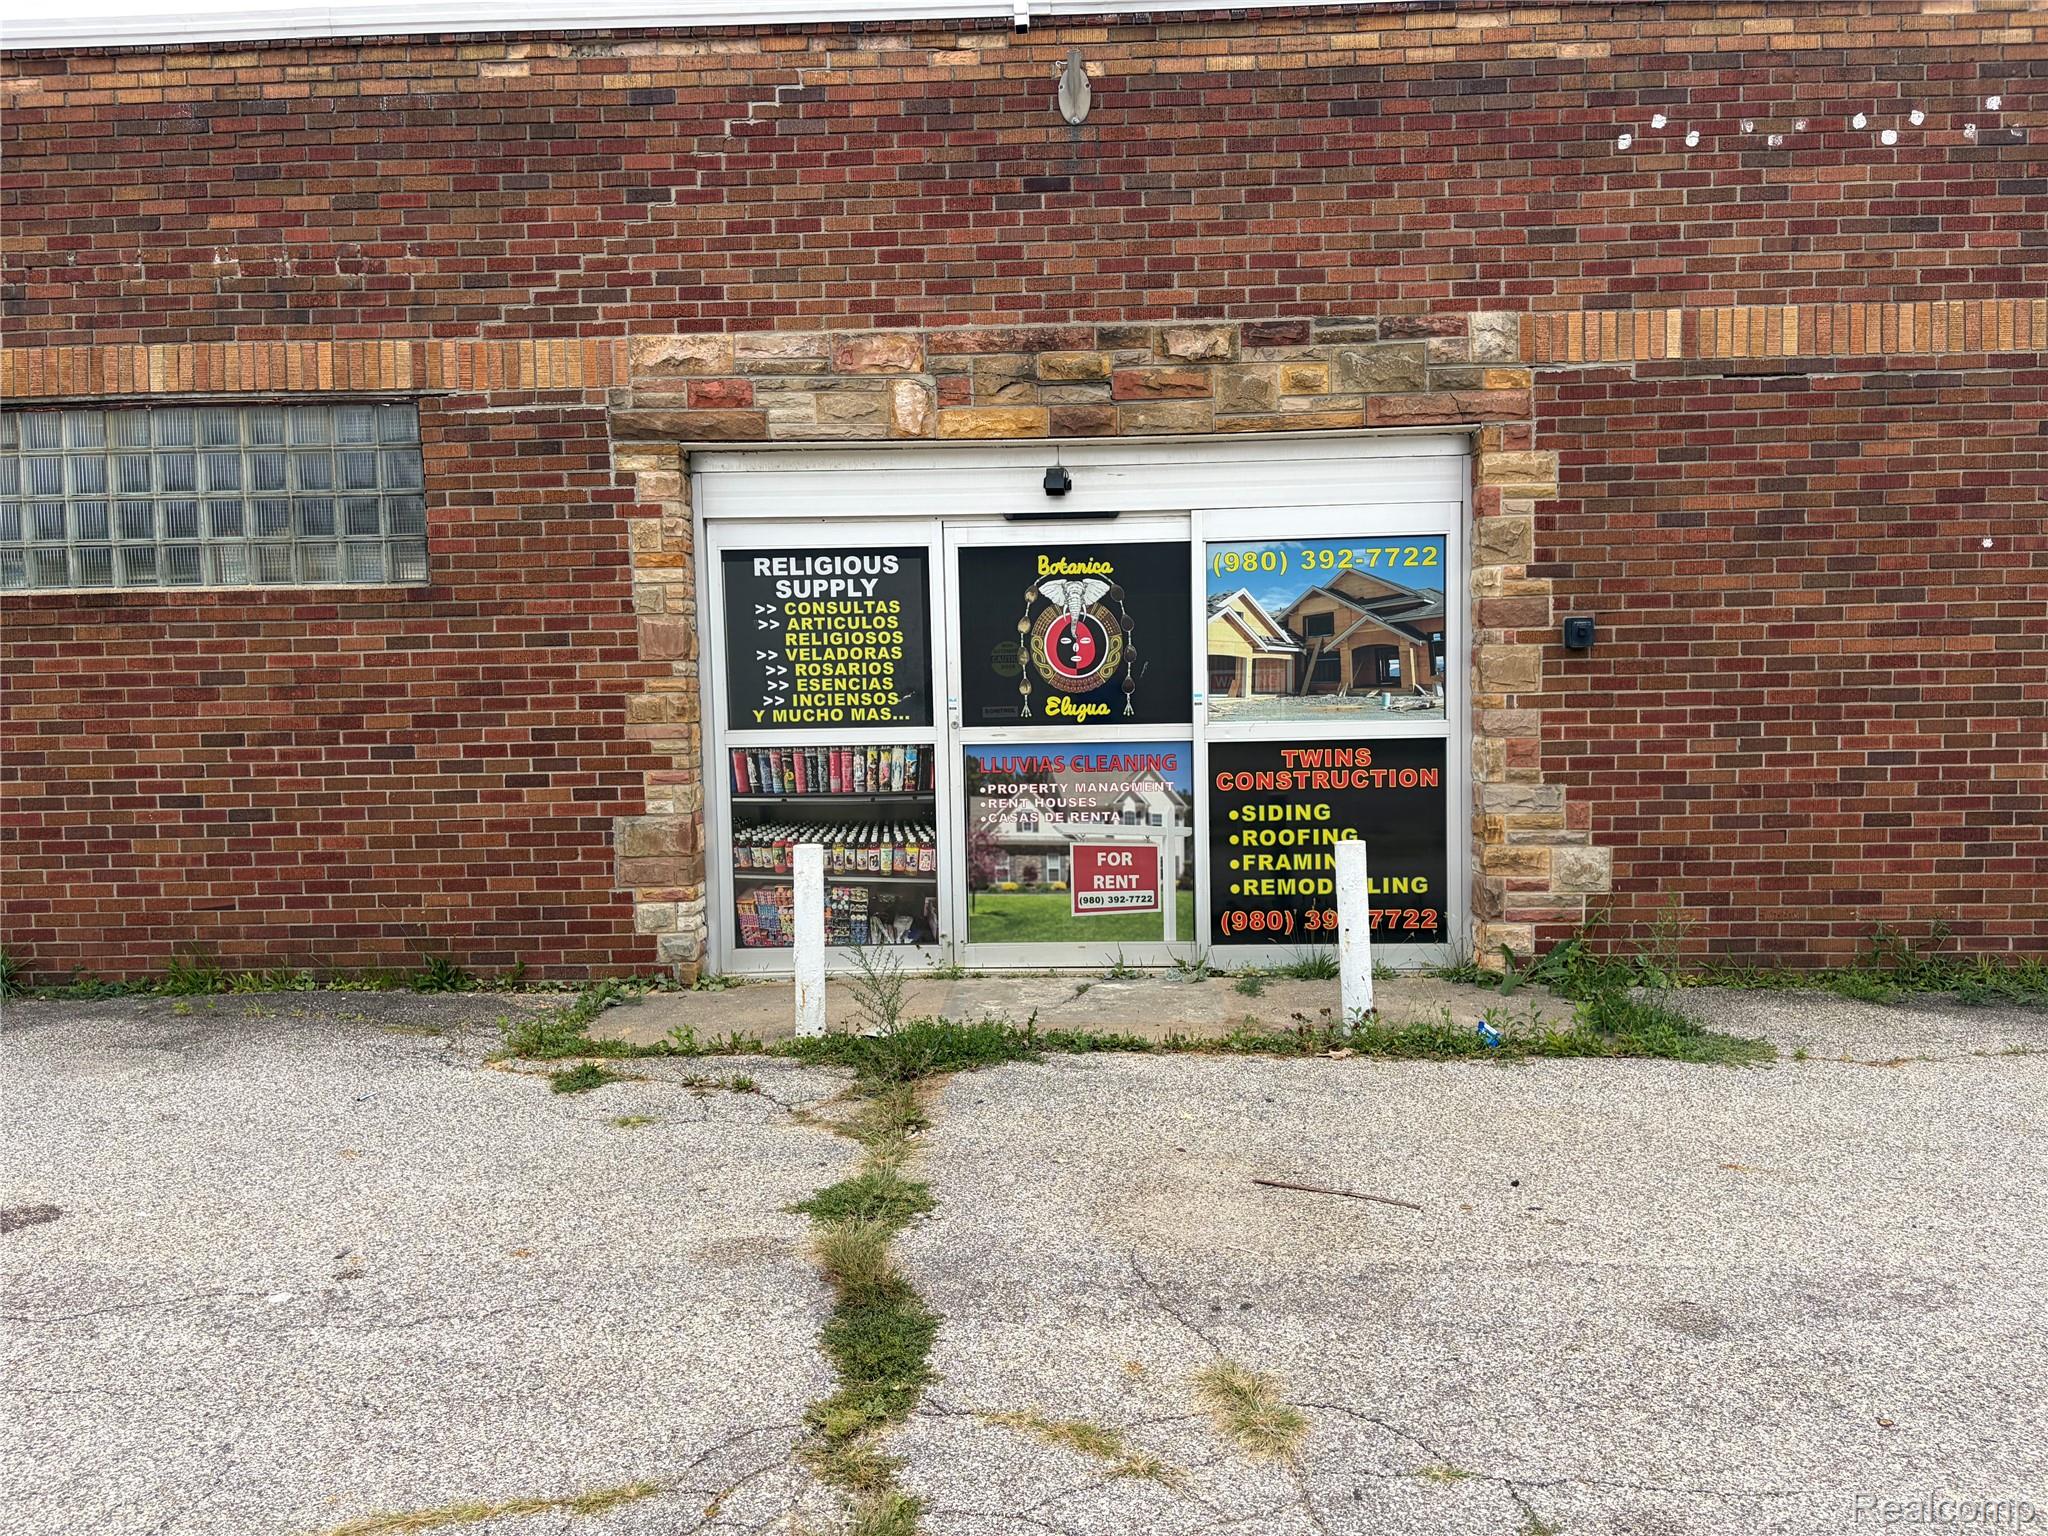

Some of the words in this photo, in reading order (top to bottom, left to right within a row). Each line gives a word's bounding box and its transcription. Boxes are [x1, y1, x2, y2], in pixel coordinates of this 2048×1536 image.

[754, 555, 899, 576] RELIGIOUS
[1037, 555, 1113, 575] Botanica
[1213, 551, 1288, 578] (980)
[1301, 546, 1438, 570] 392-7722
[776, 578, 878, 599] SUPPLY
[784, 600, 900, 615] CONSULTAS
[787, 616, 899, 630] ARTICULOS
[785, 631, 904, 646] RELIGIOSOS
[785, 646, 902, 661] VELADORAS
[795, 662, 894, 676] ROSARIOS
[796, 677, 893, 692] ESENCIAS
[792, 692, 898, 707] INCIENSOS
[753, 710, 765, 723] Y
[773, 709, 843, 723] MUCHO
[851, 707, 910, 721] MAS...
[979, 755, 1065, 774] LLUVIAS
[1070, 753, 1177, 773] CLEANING
[1281, 748, 1372, 768] TWINS
[1216, 768, 1438, 791] CONSTRUCTION
[987, 783, 1068, 794] PROPERTY
[1075, 782, 1174, 793] MANAGMENT
[988, 799, 1029, 809] RENT
[1034, 797, 1097, 808] HOUSES
[988, 813, 1039, 823] CASAS
[1045, 812, 1064, 822] DE
[1070, 811, 1121, 822] RENTA
[1241, 803, 1331, 821] SIDING
[1242, 828, 1358, 846] ROOFING
[1096, 851, 1133, 867] FOR
[1243, 853, 1337, 871] FRAMIN
[1093, 874, 1140, 890] RENT
[1079, 895, 1105, 906] (980)
[1107, 895, 1153, 904] 392-7722
[1221, 909, 1294, 935] (980)
[1304, 908, 1438, 930] 397722
